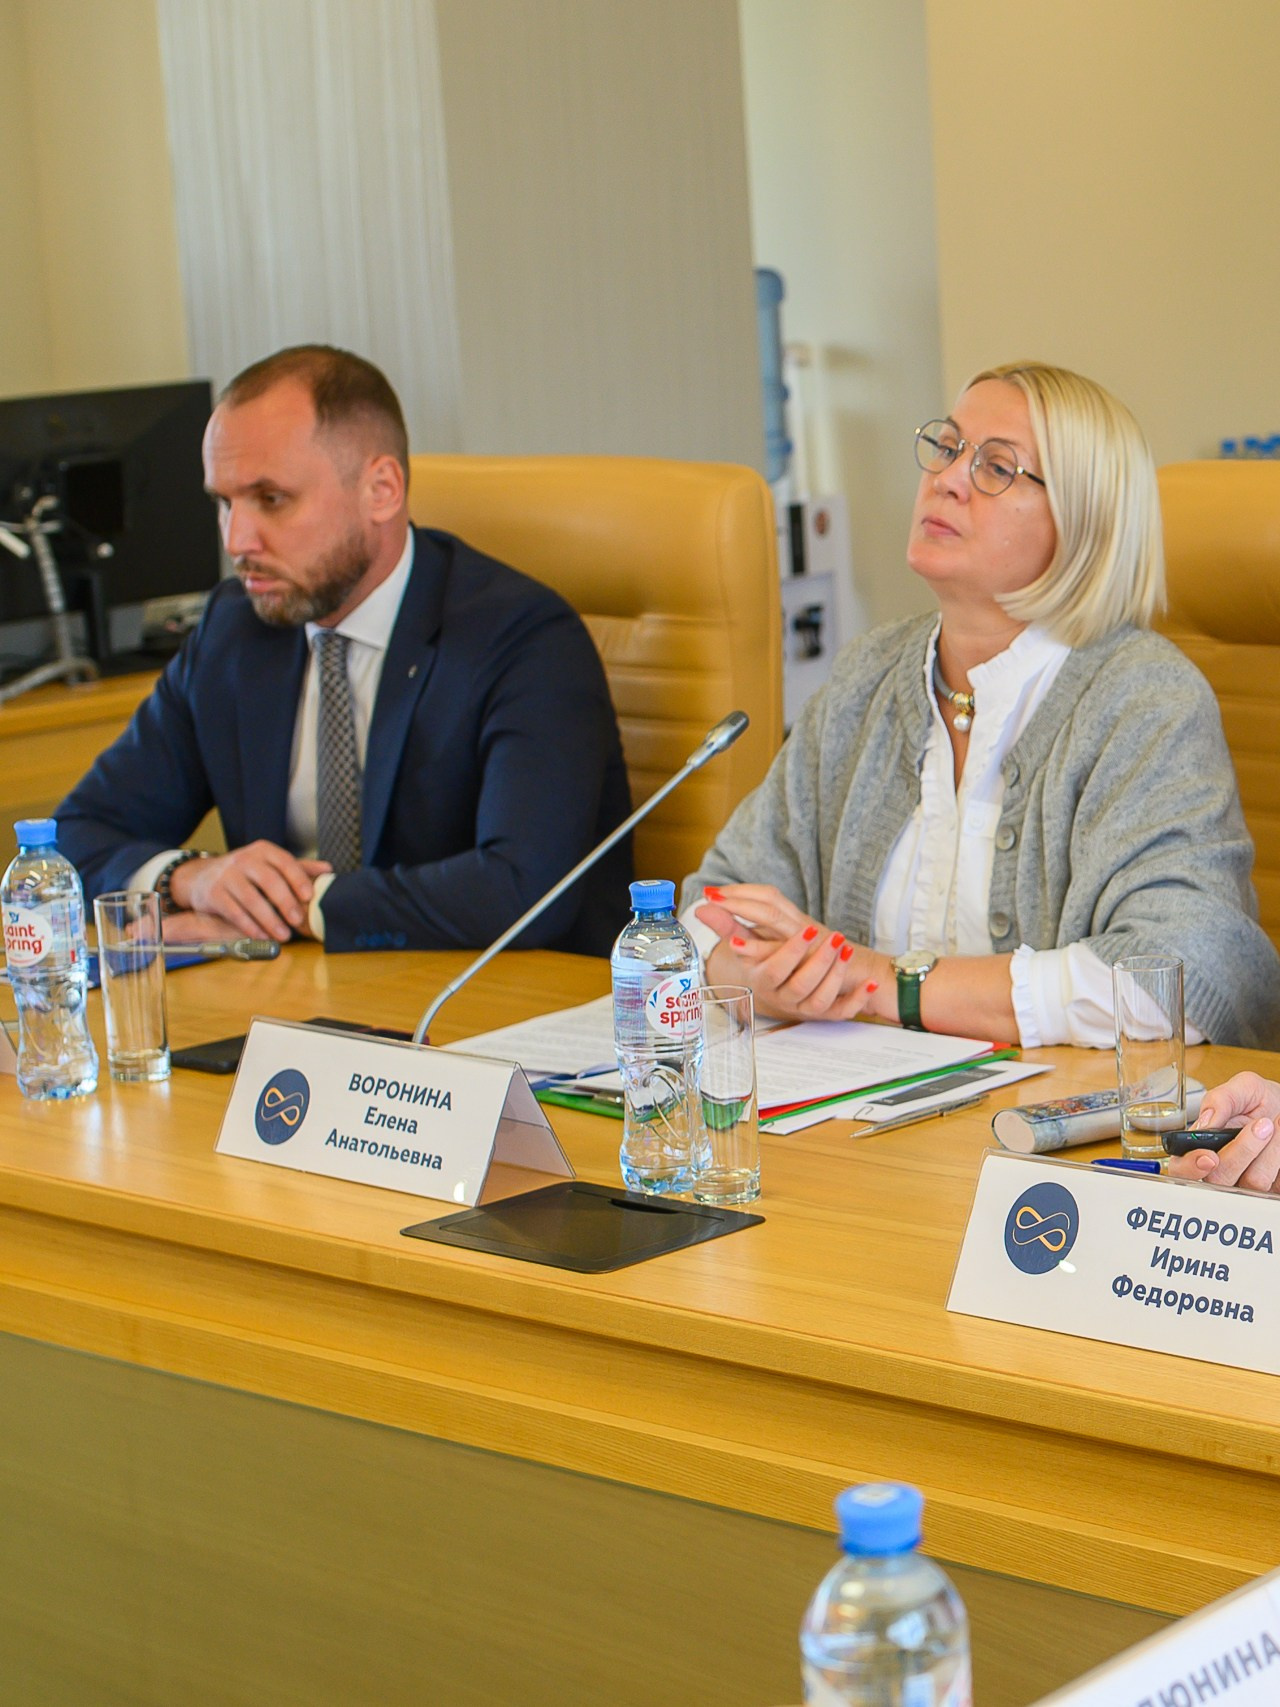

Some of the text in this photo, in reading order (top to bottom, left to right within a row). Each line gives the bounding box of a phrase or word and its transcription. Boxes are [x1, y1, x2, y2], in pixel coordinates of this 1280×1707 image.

[6, 923, 36, 938] aint
[660, 1004, 703, 1028] sprin
[348, 1073, 452, 1111] ВОРОНИНА
[363, 1106, 418, 1135] Елена
[324, 1128, 443, 1171] Анатольевна
[1126, 1206, 1274, 1254] ФЕДОРОВА
[1150, 1245, 1230, 1282] Ирина
[1111, 1273, 1255, 1323] Федоровна
